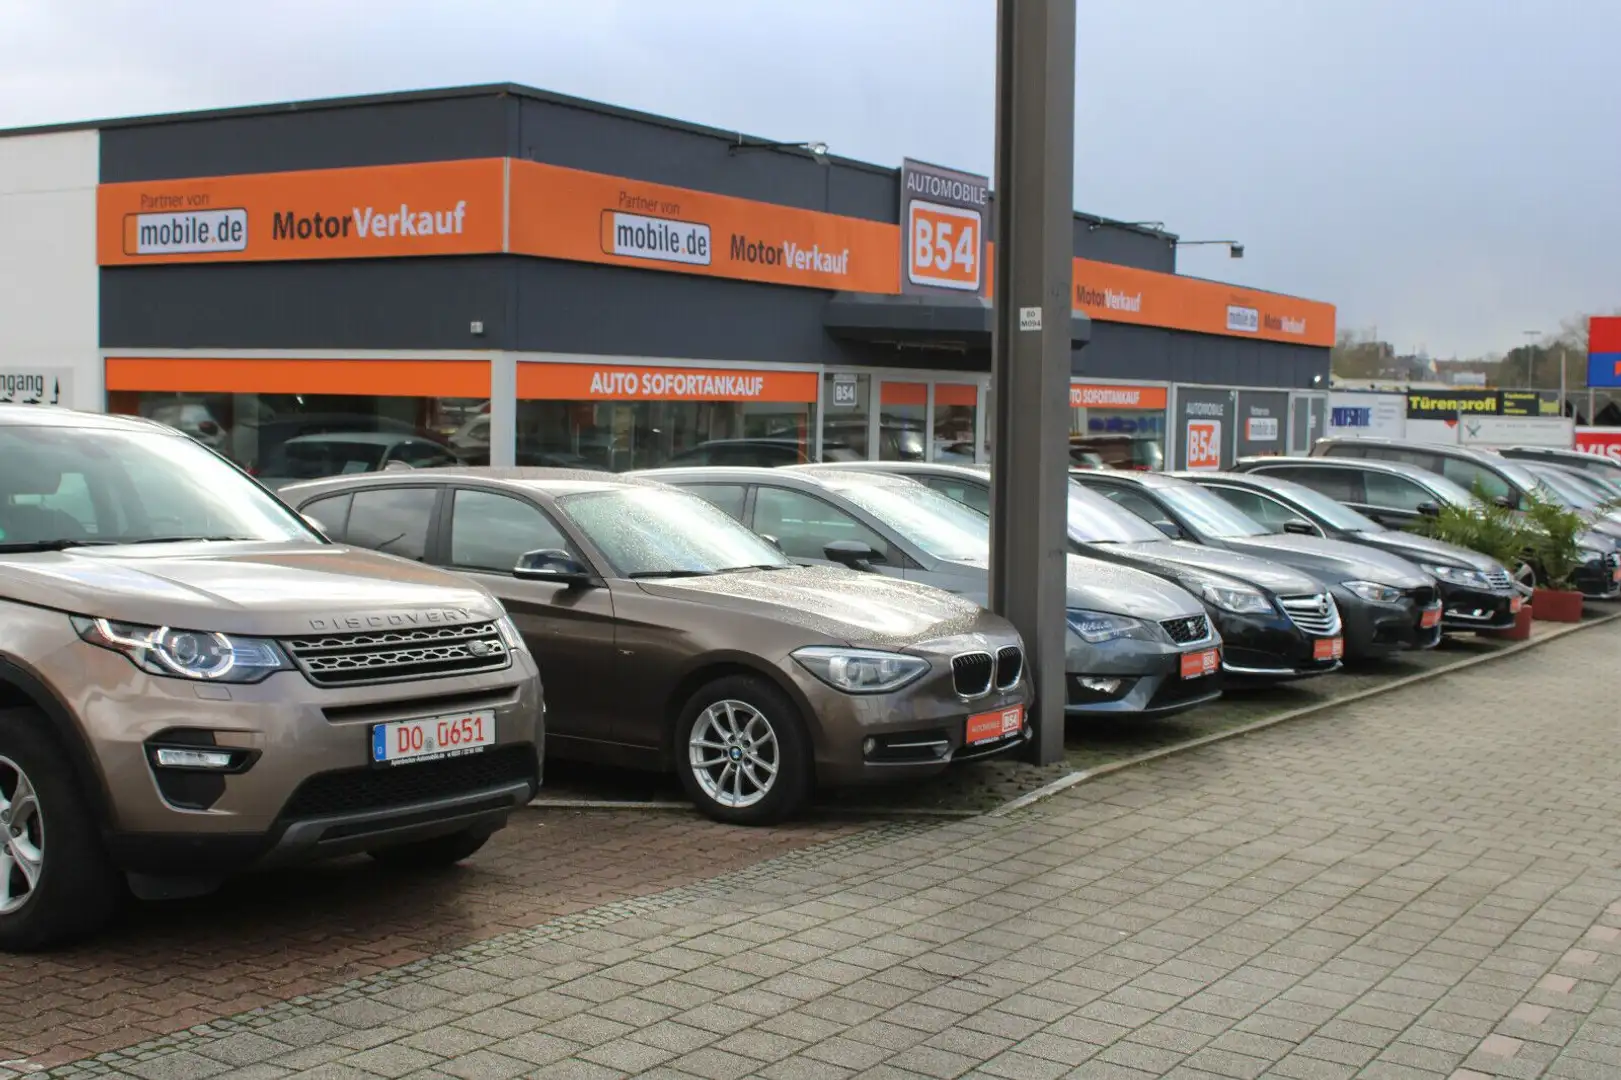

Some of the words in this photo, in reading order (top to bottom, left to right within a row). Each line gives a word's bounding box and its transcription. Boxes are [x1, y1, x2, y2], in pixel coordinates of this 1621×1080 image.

[139, 192, 183, 209] Partner
[186, 192, 210, 207] von
[618, 190, 658, 212] Partner
[661, 201, 680, 215] von
[906, 173, 987, 206] AUTOMOBILE
[140, 215, 243, 247] mobile.de
[271, 200, 467, 241] MotorVerkauf
[616, 222, 708, 257] mobile.de
[914, 218, 976, 274] B54
[730, 233, 850, 275] MotorVerkauf
[1076, 284, 1142, 312] MotorVerkauf
[0, 374, 44, 397] ngang
[589, 371, 639, 395] AUTO
[641, 373, 764, 397] SOFORTANKAUF
[835, 384, 855, 402] B54
[1408, 395, 1497, 412] Türenprofi
[1189, 430, 1219, 462] B54
[309, 608, 470, 630] DISCOVERY
[397, 725, 424, 753] DO
